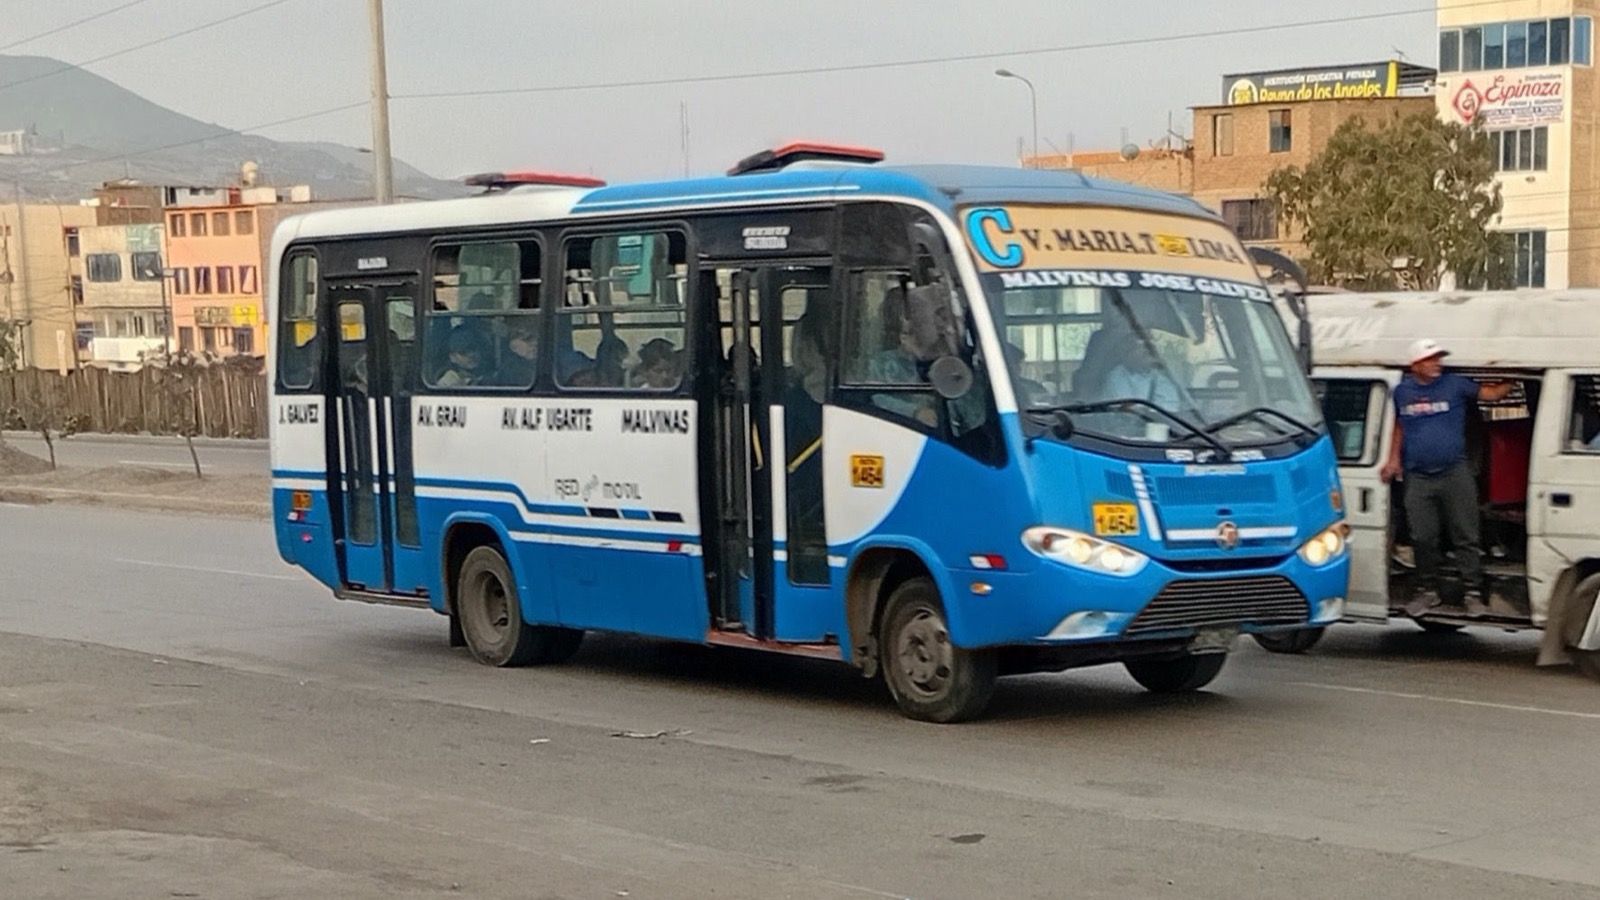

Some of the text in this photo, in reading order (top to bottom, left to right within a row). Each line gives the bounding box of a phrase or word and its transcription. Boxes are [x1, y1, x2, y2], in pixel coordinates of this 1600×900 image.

[1296, 83, 1312, 100] de
[1313, 82, 1332, 99] los
[1485, 75, 1562, 106] Espinoza
[965, 208, 1024, 268] C
[1019, 228, 1052, 251] V.
[1189, 237, 1246, 264] LIMA
[1000, 271, 1272, 302] MALVINAS JOSE GALVEZ
[288, 403, 319, 424] GALVEZ
[417, 405, 467, 428] AV. GRAU
[501, 407, 593, 432] AV. ALF UGARTE
[621, 409, 689, 435] MALVINAS
